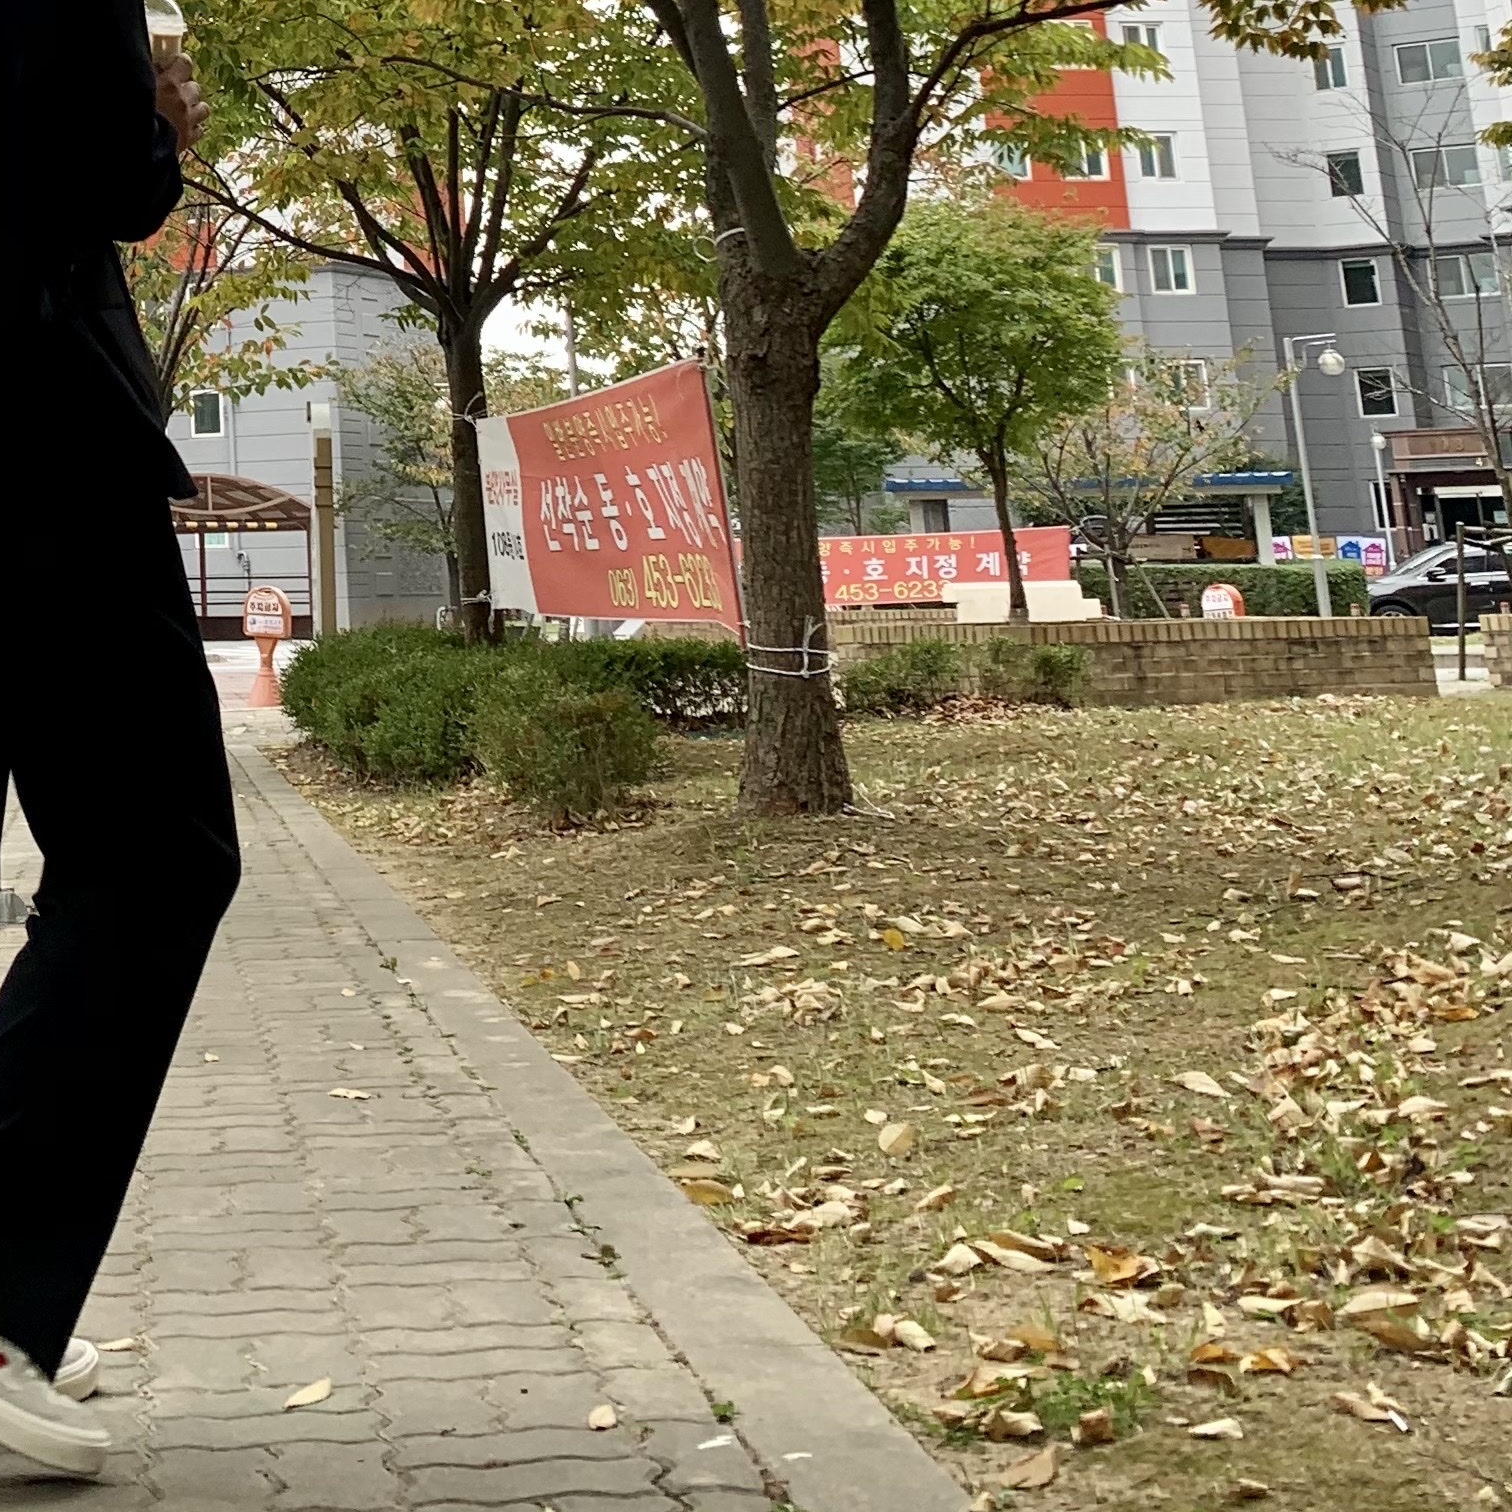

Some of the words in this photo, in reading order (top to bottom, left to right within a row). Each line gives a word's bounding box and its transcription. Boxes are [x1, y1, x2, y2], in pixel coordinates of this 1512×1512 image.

[541, 475, 600, 552] 선착순
[905, 554, 957, 579] 지정
[608, 568, 639, 610] 063)
